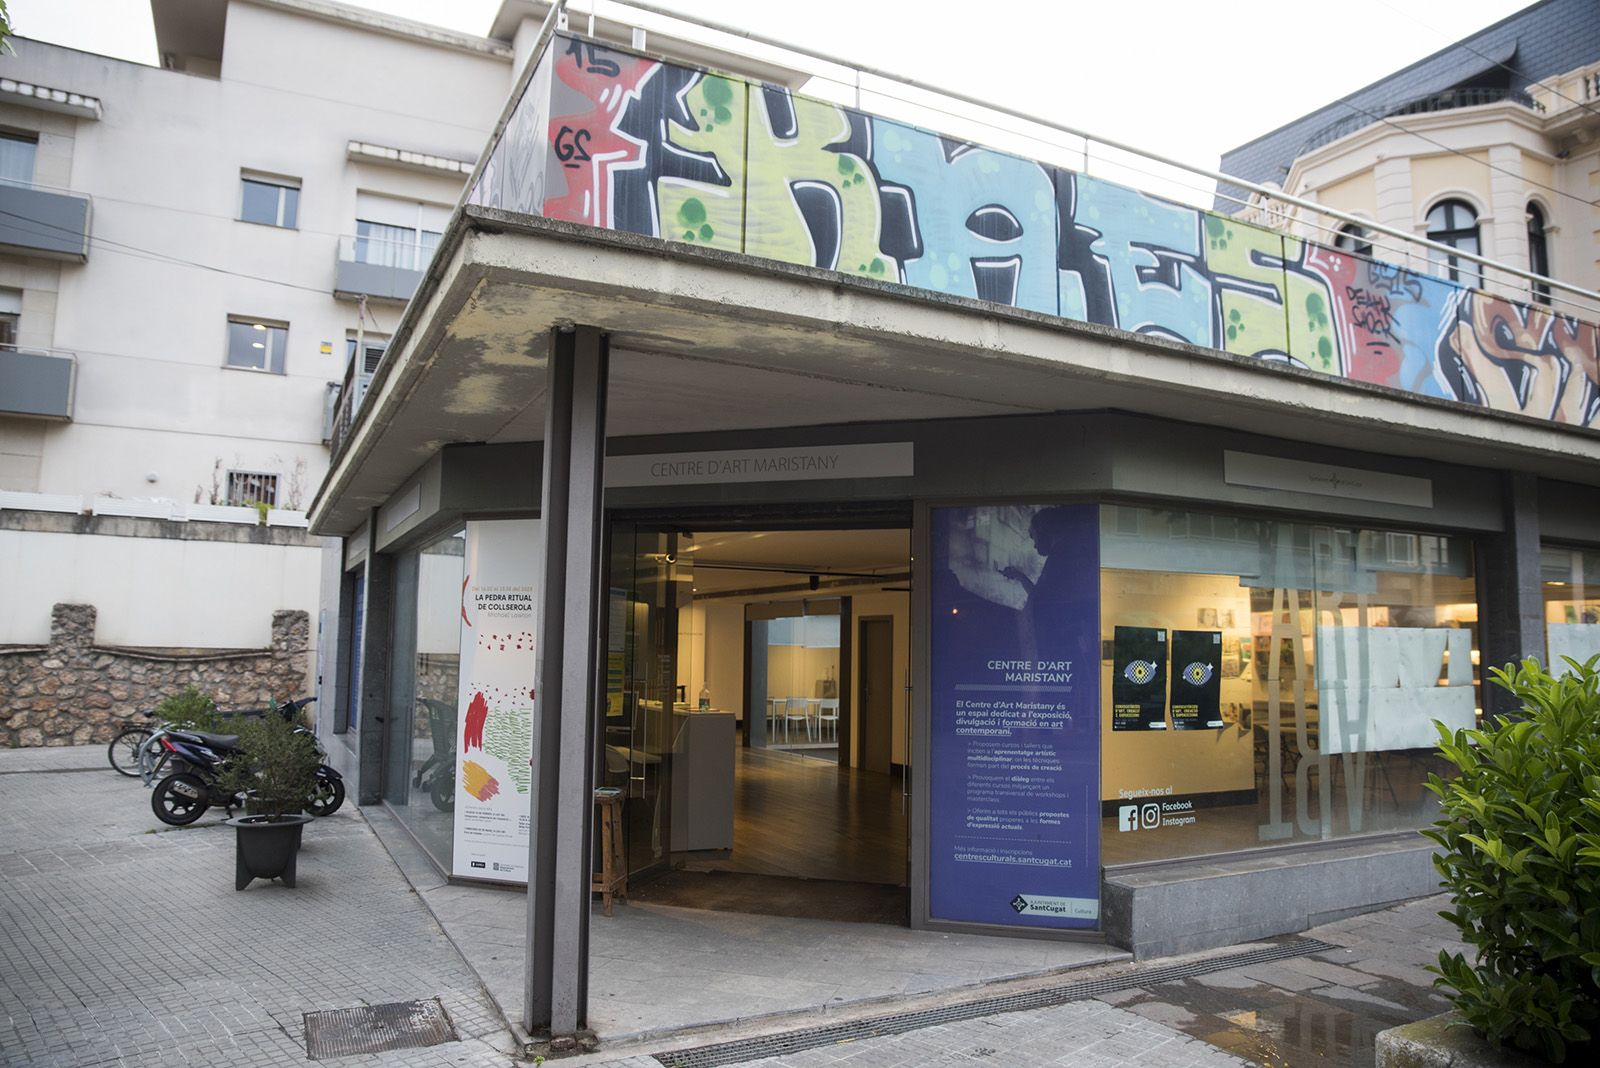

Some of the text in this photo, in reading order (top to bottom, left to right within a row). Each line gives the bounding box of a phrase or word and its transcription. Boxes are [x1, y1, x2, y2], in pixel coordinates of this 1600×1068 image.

[650, 455, 839, 478] CENTRE D'ART MARISTANY
[987, 660, 1072, 671] CENTRE D'ART
[1005, 672, 1072, 682] MARISTANY
[1016, 702, 1054, 711] Maristany
[1056, 702, 1066, 710] és
[968, 710, 988, 719] espai
[990, 710, 1020, 718] dedicat
[1028, 710, 1072, 720] l'exposició,
[956, 718, 996, 726] divulgació
[956, 728, 1012, 736] contemporani.
[1120, 788, 1164, 800] Segueix-nos
[1162, 800, 1192, 811] Facebook
[1163, 816, 1196, 826] Instagram
[954, 853, 1072, 866] centresculturals.santcugat.cat
[1030, 904, 1066, 912] SantCugat
